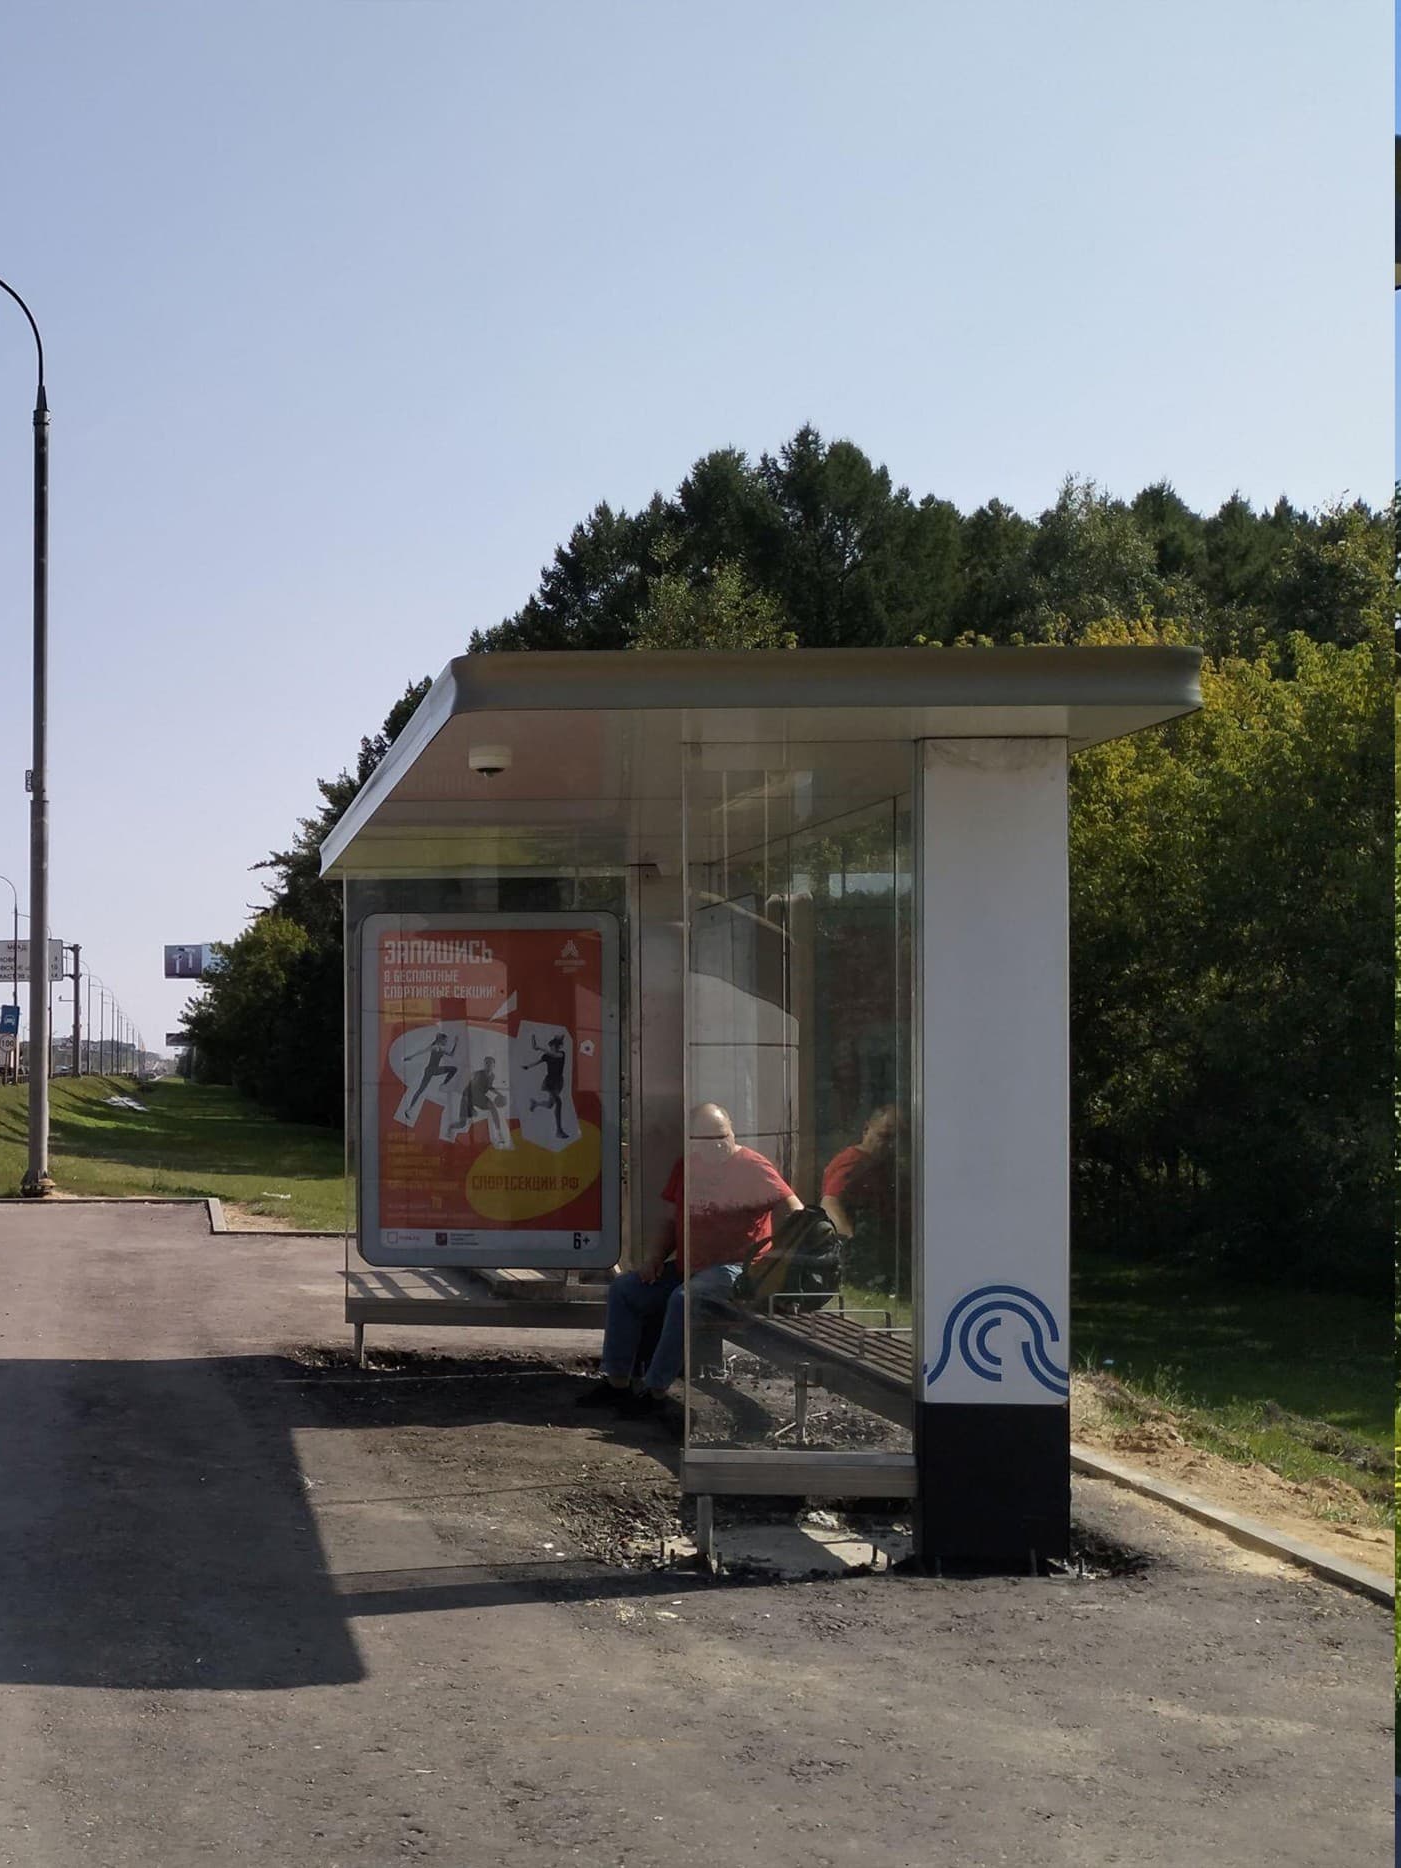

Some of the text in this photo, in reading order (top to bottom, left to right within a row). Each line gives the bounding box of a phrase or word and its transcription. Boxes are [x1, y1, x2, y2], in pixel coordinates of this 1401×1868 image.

[384, 940, 493, 964] ЗАПИШИСЬ
[384, 970, 459, 982] В БЕСПЛАТНЫЕ
[384, 986, 450, 999] СПОРТИВНЫЕ
[1, 1039, 15, 1048] 100
[573, 1232, 590, 1250] 6+
